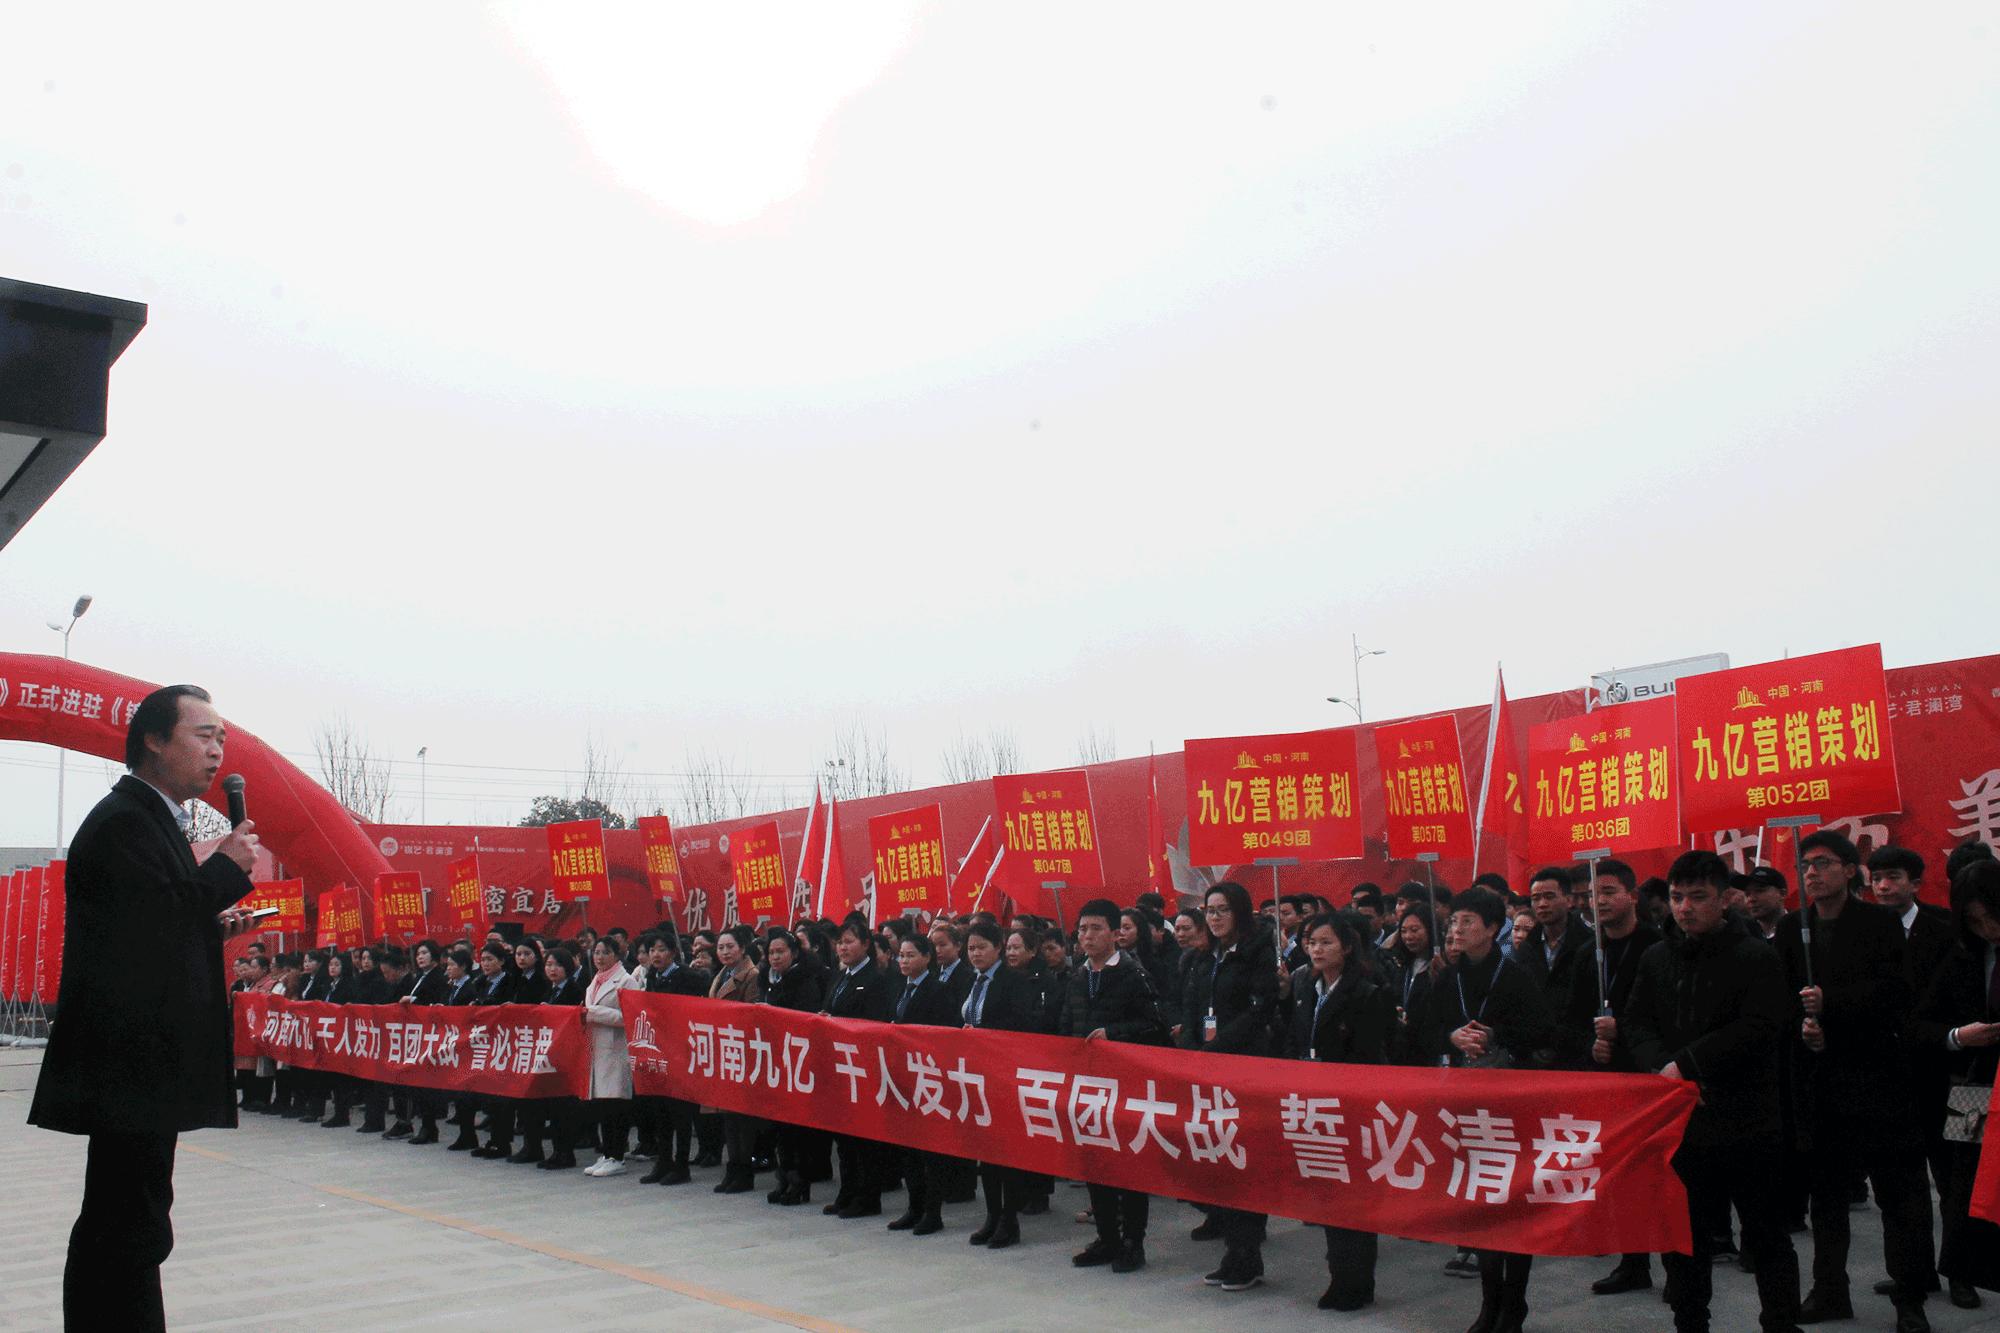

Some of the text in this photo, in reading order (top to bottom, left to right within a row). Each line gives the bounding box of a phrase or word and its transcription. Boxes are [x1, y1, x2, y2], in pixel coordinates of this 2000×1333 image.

[1633, 681, 1675, 697] BUI
[1692, 700, 1880, 782] 九亿营销策划
[1197, 771, 1352, 825] 九亿营销策划
[1386, 762, 1464, 816] 九亿营销策划
[1536, 745, 1669, 819] 九亿营销策划
[1746, 779, 1830, 809] 第052团
[1005, 808, 1093, 852] 九亿营销策划
[1242, 829, 1311, 849] 第049团
[1411, 825, 1447, 843] 第057团
[1571, 816, 1630, 843] 第036团
[553, 845, 604, 877] 九亿营销策划
[736, 853, 783, 894] 九亿营销策划
[876, 838, 943, 885] 九亿营销策划
[1033, 859, 1073, 874] 第047团
[385, 1022, 460, 1069] 百团大战
[468, 1023, 558, 1074] 誓必清盘
[687, 1019, 815, 1095] 河南九亿
[1015, 1067, 1248, 1170] 百团大战
[1279, 1092, 1602, 1204] 誓必清盘
